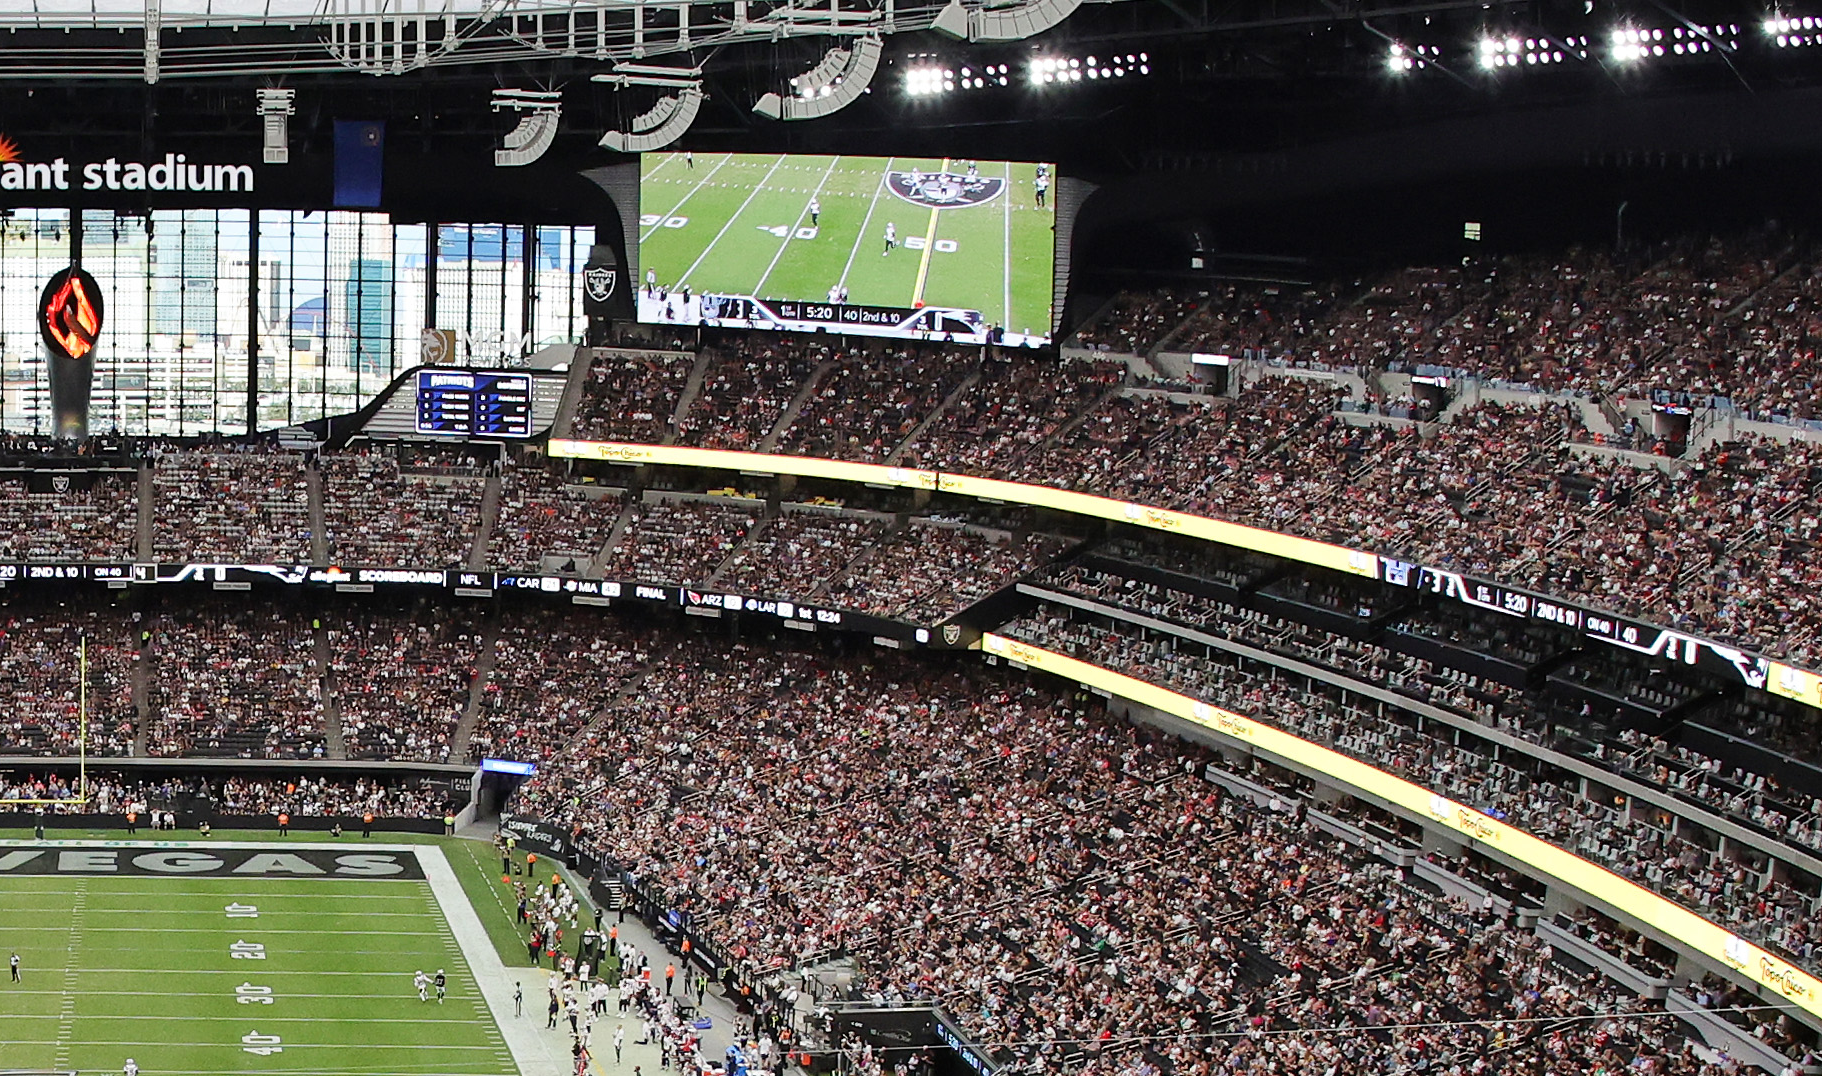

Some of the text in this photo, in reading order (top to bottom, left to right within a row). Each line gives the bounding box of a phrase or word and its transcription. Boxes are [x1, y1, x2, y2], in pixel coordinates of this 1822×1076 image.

[82, 153, 254, 192] stadium
[806, 307, 833, 319] 5:20
[844, 309, 858, 320] 40
[863, 311, 900, 323] 2nd & 10
[462, 331, 532, 354] MGM
[430, 375, 475, 388] PATRIOTS
[31, 567, 78, 578] 2ND & 10
[95, 568, 122, 577] ON 40
[359, 569, 443, 584] SCOREBOARD
[460, 573, 481, 586] NFL
[516, 577, 540, 589] CAR
[578, 582, 598, 594] MIA
[636, 586, 666, 600] FINAL
[701, 592, 722, 606] ARZ
[758, 600, 776, 614] LAR
[1504, 592, 1529, 612] 5:20
[798, 606, 841, 624] 1st 12:24
[1537, 603, 1578, 626] 2ND & 10
[1587, 617, 1612, 634] ON 40
[1622, 626, 1639, 643] 40
[224, 905, 259, 918] 10
[230, 943, 267, 960] 20
[235, 986, 274, 1005] 30
[241, 1034, 283, 1056] 40
